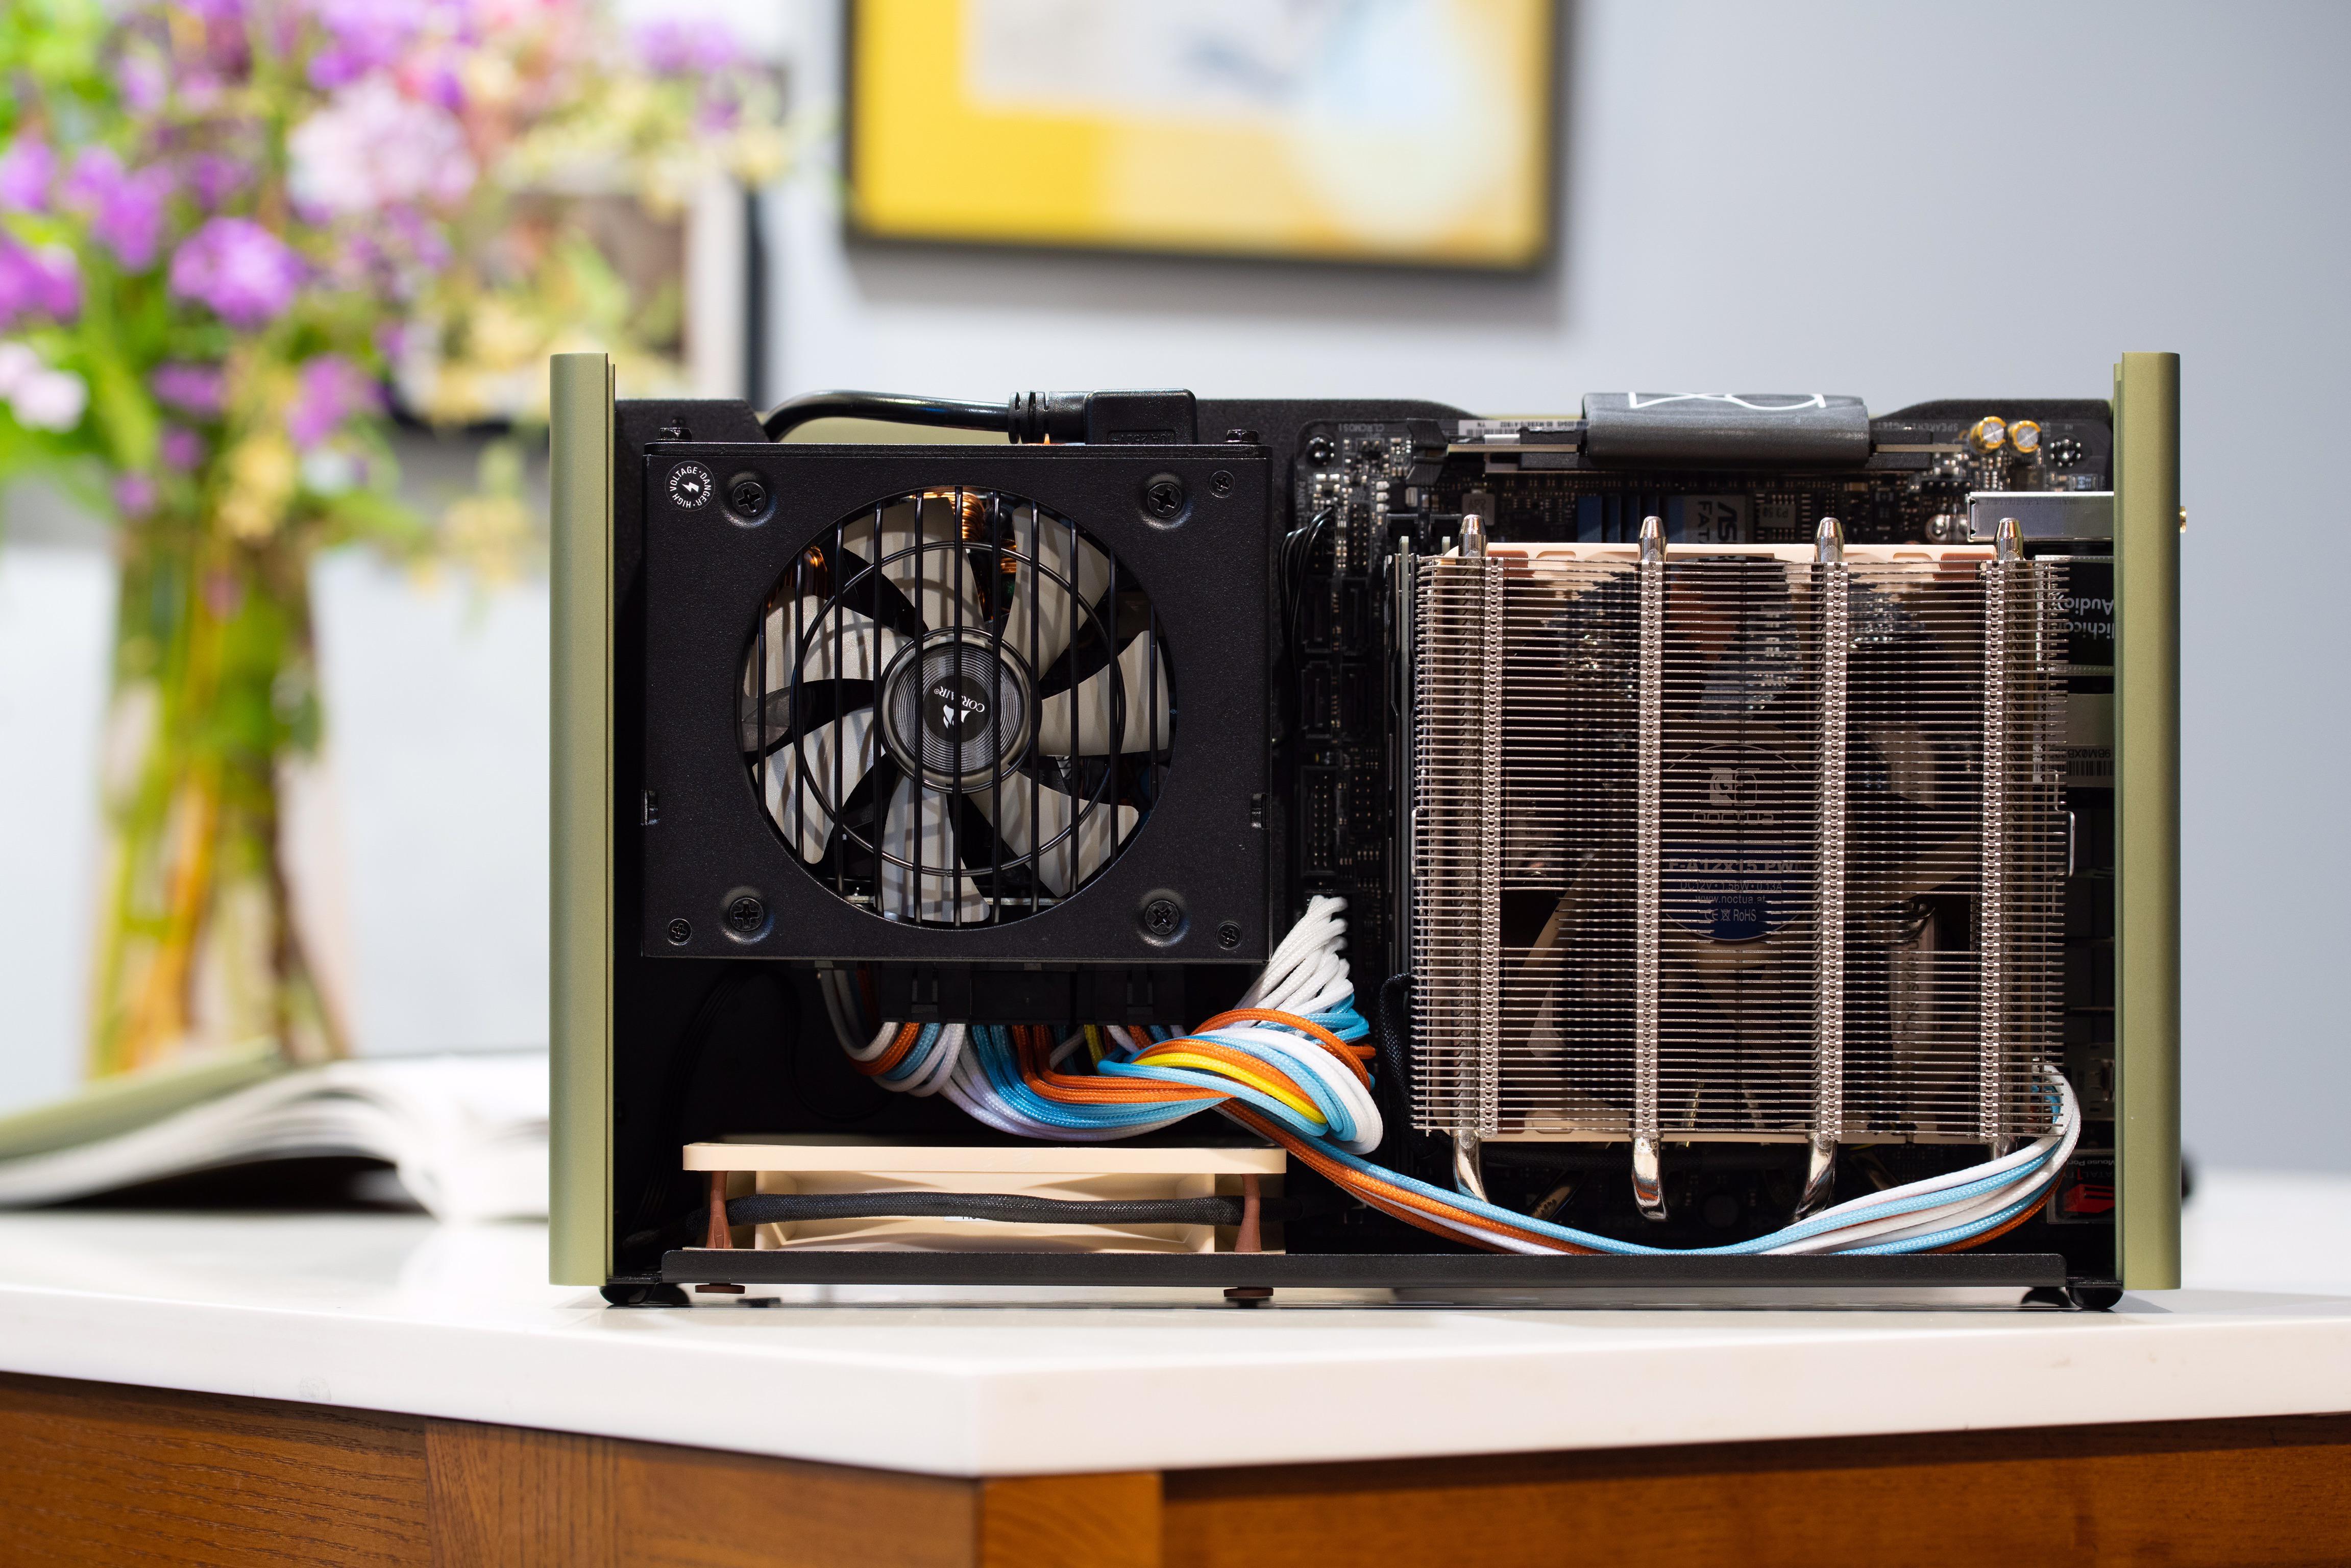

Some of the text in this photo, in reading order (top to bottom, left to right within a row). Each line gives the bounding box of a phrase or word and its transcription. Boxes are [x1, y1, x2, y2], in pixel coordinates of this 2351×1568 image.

[669, 466, 712, 508] DANGER HIGH VOLTAGE
[1693, 813, 1774, 825] noctua
[1695, 894, 1766, 904] www.noctua.at
[1733, 909, 1756, 922] RoHS
